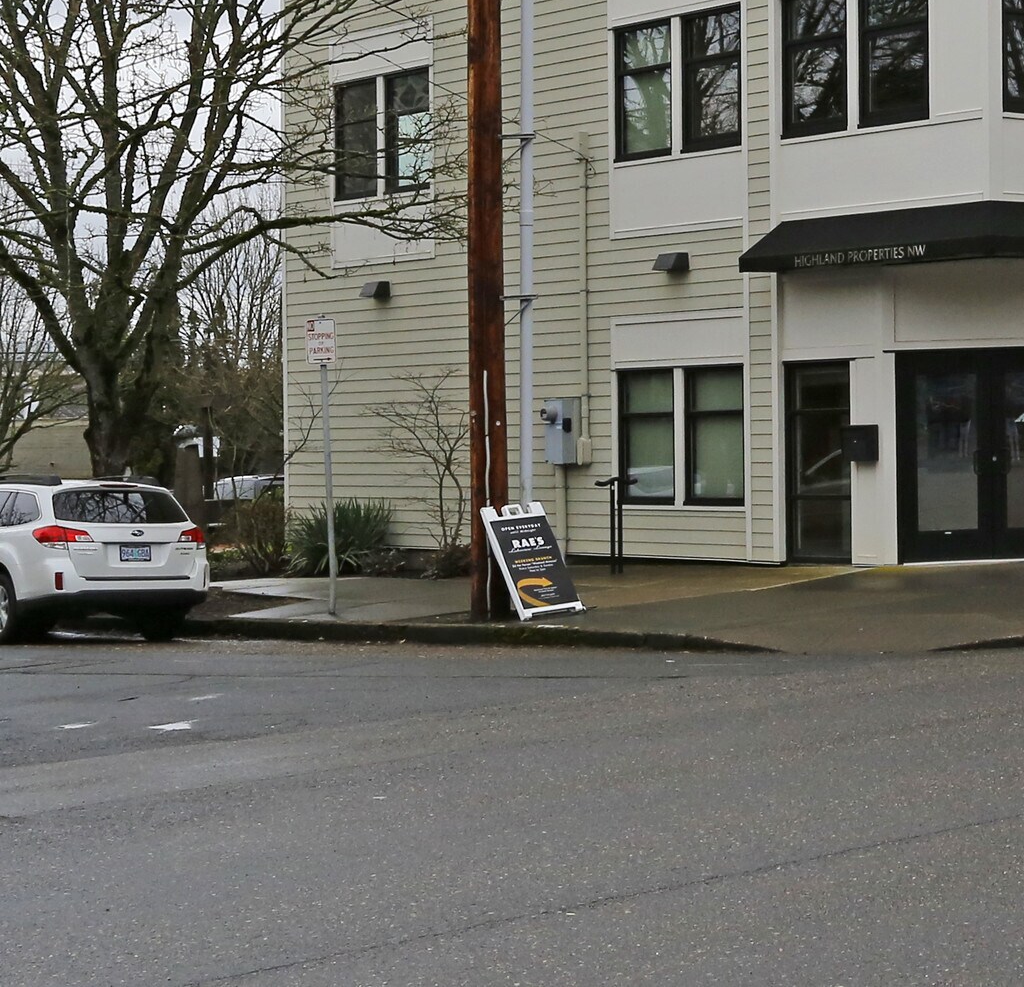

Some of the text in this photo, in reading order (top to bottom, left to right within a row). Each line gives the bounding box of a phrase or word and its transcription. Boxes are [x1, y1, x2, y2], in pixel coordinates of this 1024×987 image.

[794, 244, 926, 268] HIGHLAND PROPERTIES NW
[309, 346, 334, 354] PARKING
[512, 536, 544, 548] RAE'S
